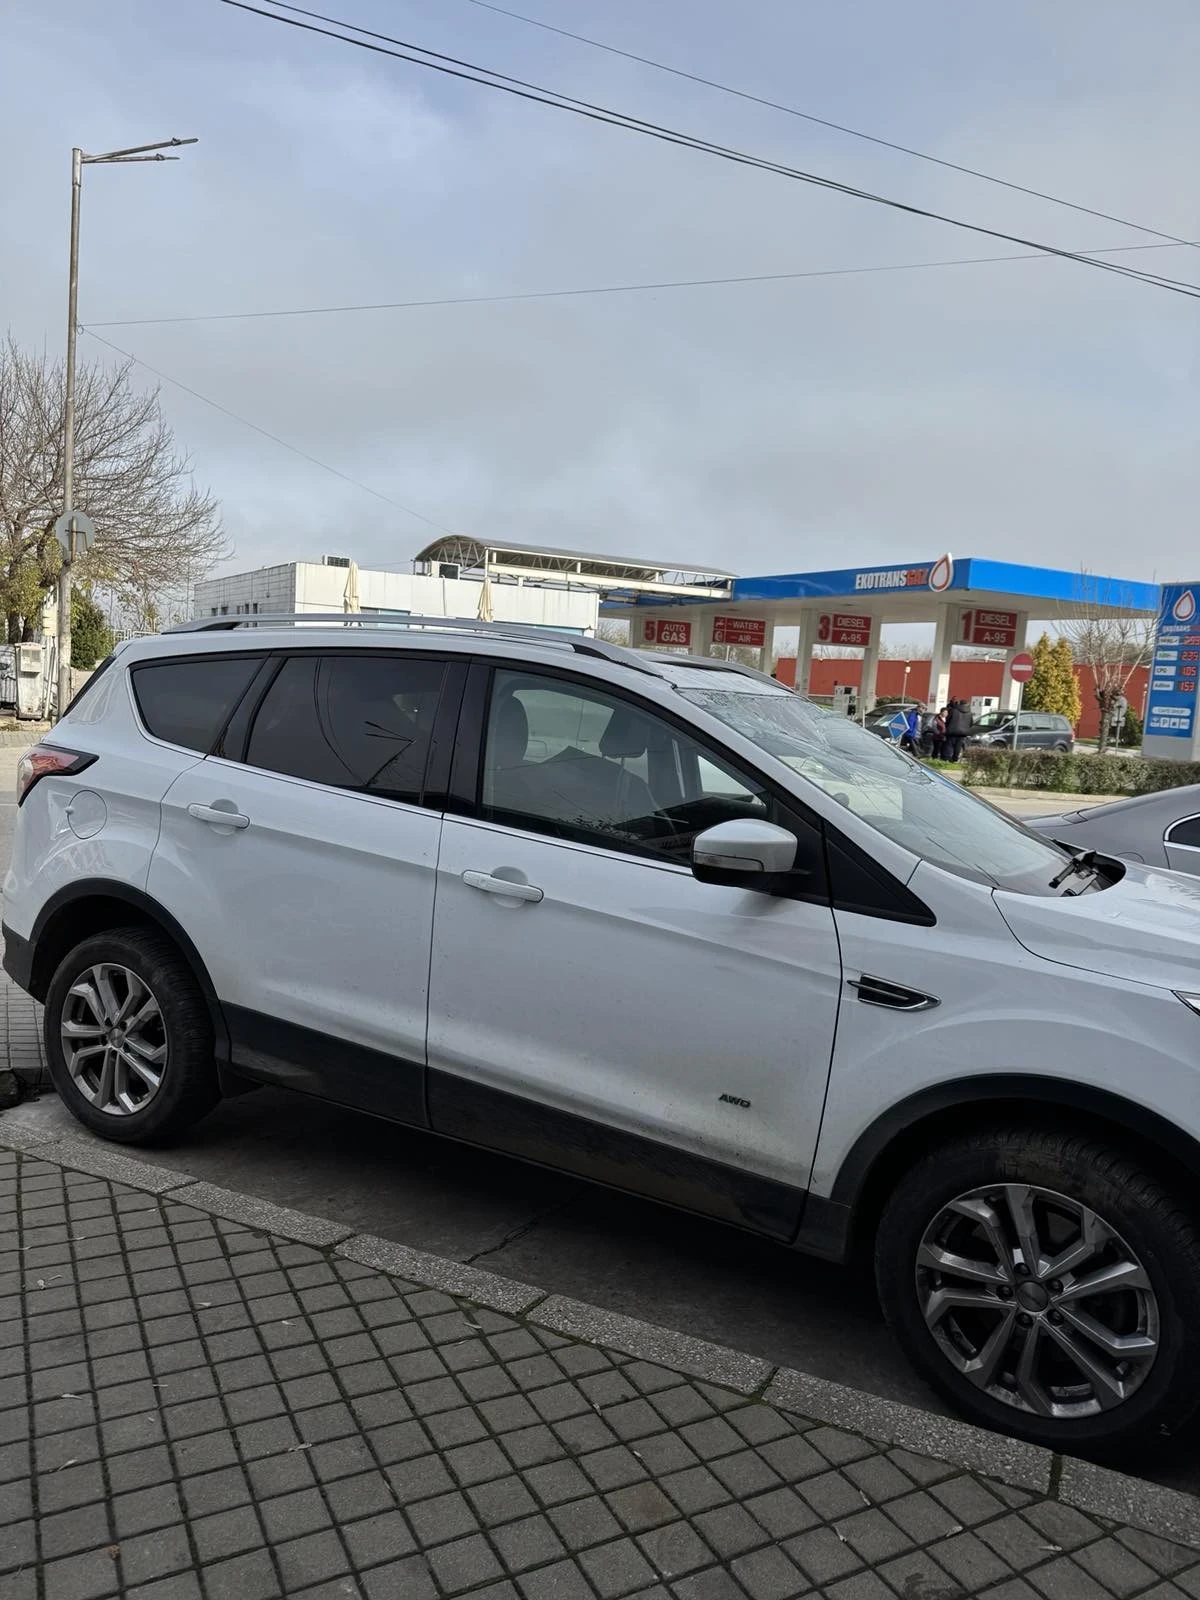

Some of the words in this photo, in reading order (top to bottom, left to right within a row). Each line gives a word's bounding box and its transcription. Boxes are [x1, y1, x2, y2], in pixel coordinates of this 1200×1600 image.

[837, 617, 867, 628] DIESEL
[961, 610, 973, 641] 1
[980, 613, 1013, 626] DIESEL
[644, 620, 656, 641] 5
[663, 623, 687, 633] AUTO
[818, 615, 831, 641] 3
[661, 631, 687, 643] GAS
[738, 634, 752, 643] AIR
[840, 632, 862, 643] A-95
[983, 631, 1008, 643] A-95
[718, 1093, 751, 1108] AWD
